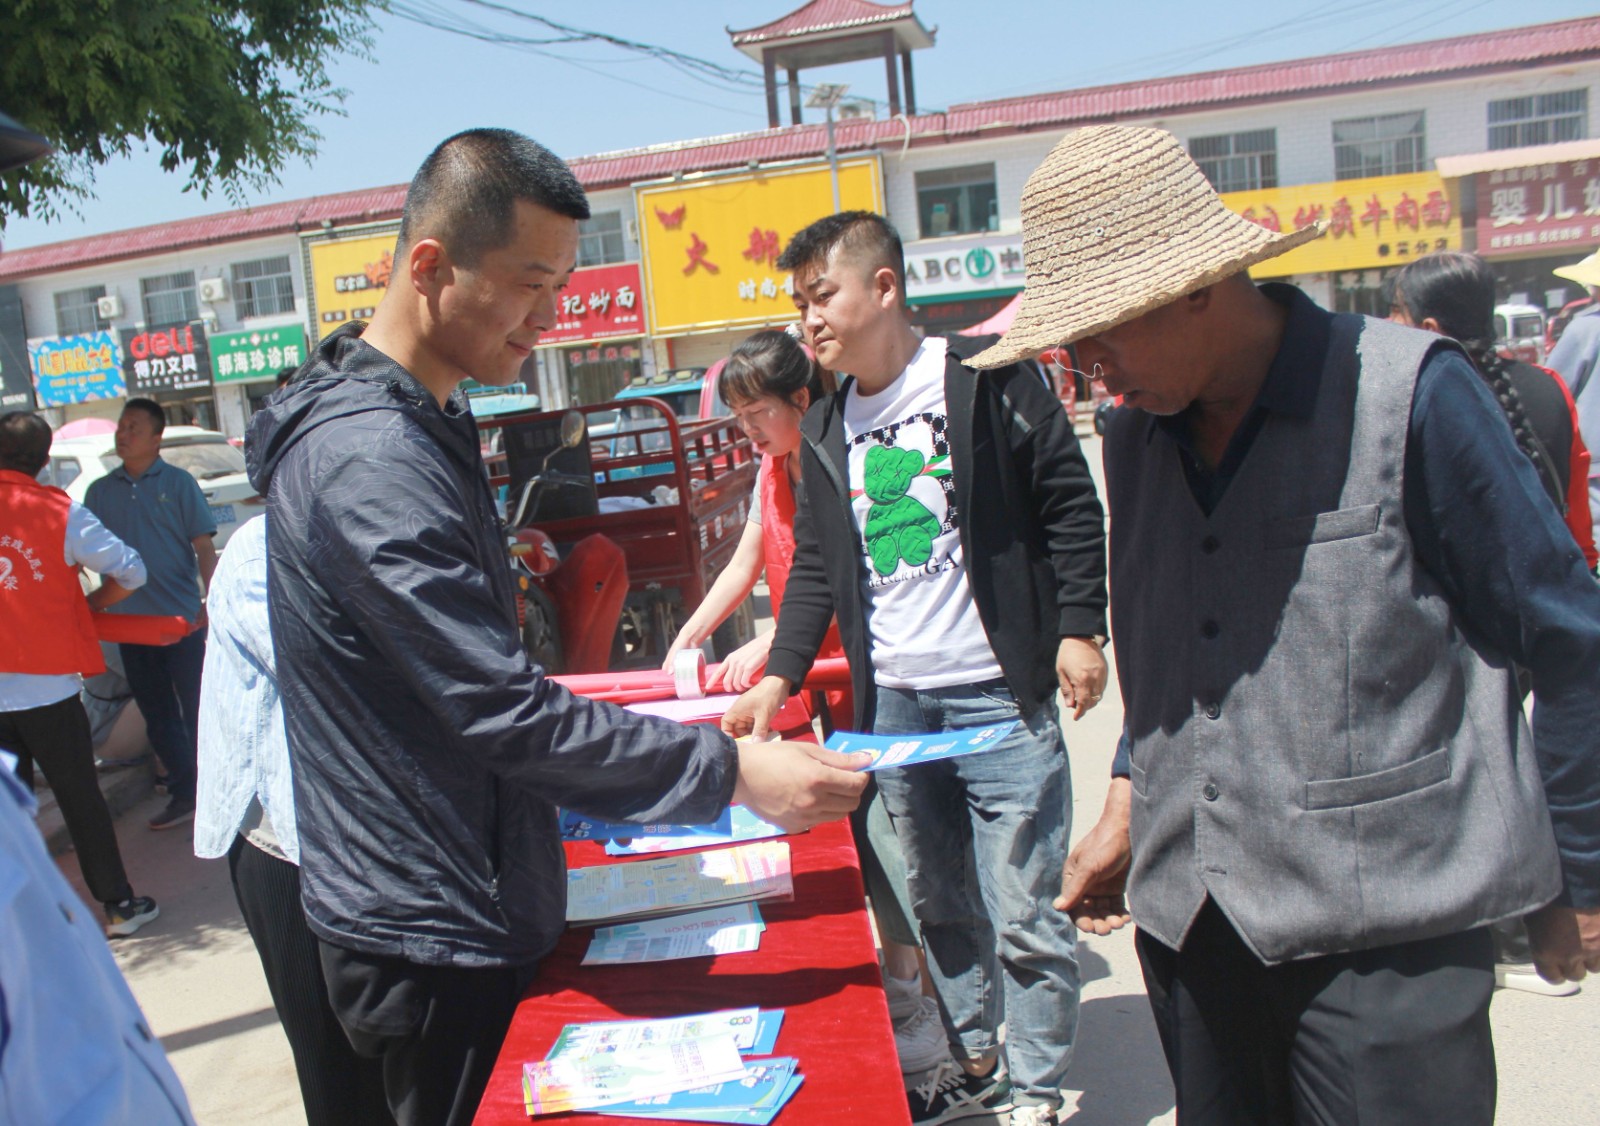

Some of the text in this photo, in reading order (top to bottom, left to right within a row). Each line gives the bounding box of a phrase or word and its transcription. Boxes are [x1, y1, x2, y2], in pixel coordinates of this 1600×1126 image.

[906, 247, 1021, 281] ABC 中
[556, 285, 635, 316] 记炒面
[130, 324, 194, 361] deli
[133, 353, 198, 380] 得力文具
[217, 345, 299, 377] 郭海珍诊所
